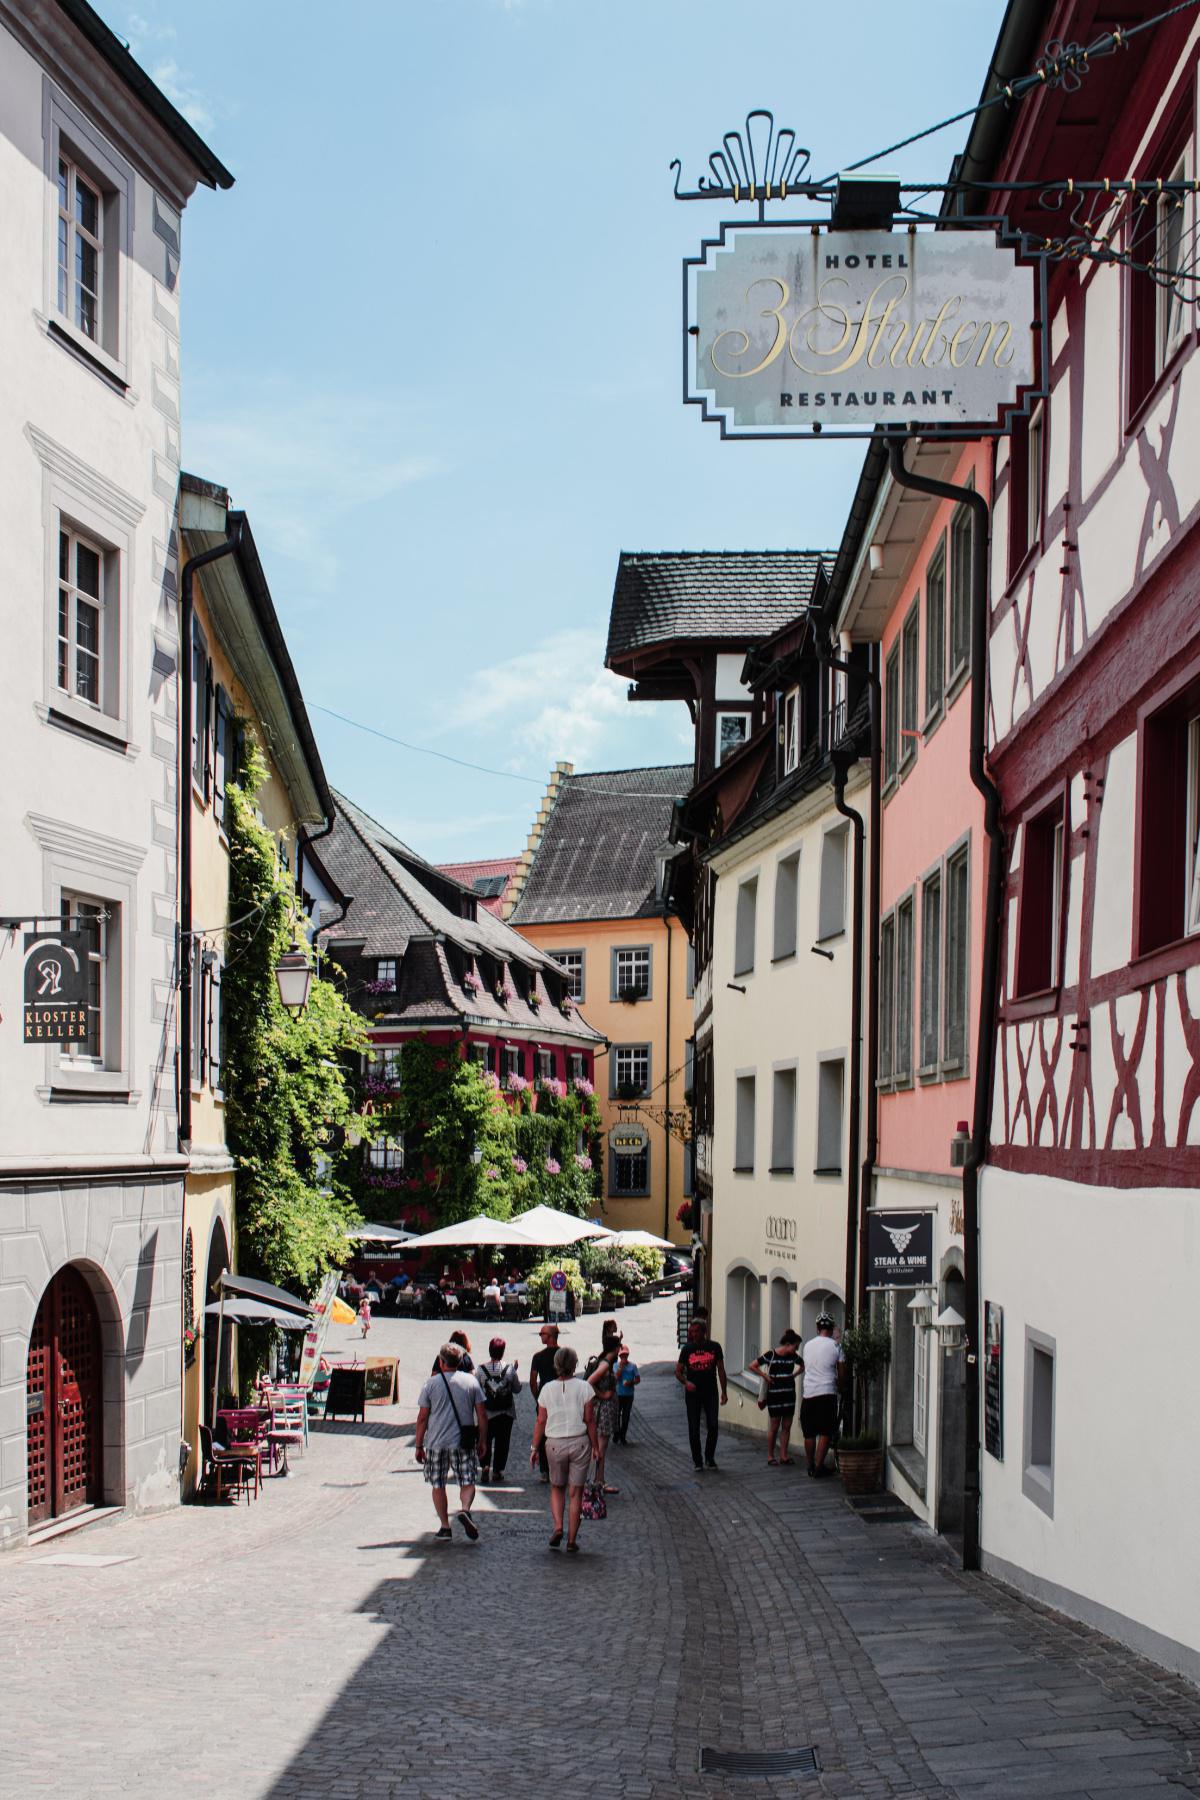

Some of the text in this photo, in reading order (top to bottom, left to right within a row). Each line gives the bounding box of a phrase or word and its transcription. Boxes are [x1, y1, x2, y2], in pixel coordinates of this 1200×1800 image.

[825, 254, 909, 269] HOTEL
[711, 274, 1015, 378] 3 Stuben
[780, 390, 954, 407] RESTAURANT
[25, 1011, 86, 1023] KLOSTER
[25, 1025, 86, 1037] KELLER
[874, 1255, 927, 1266] STEAK & WINE
